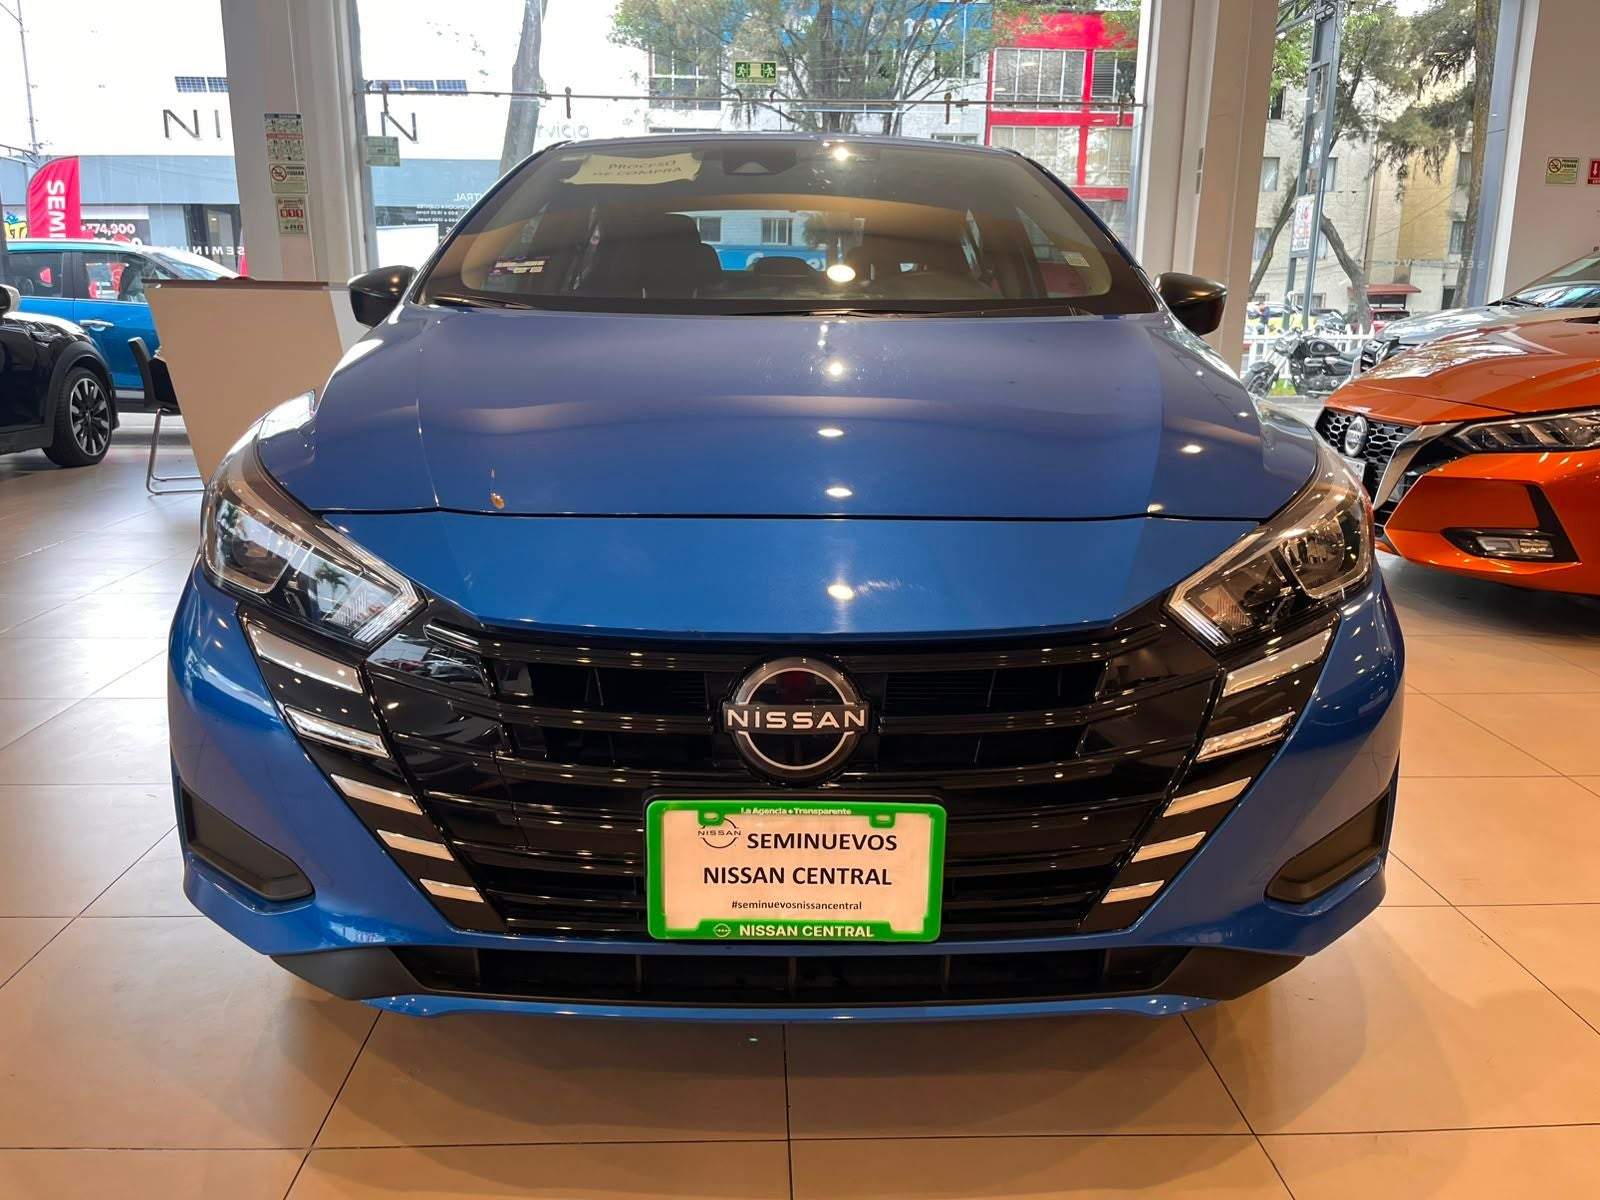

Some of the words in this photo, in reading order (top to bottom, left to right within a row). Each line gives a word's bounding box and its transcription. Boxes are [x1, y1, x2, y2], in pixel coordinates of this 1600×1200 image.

[537, 122, 590, 139] rvicio
[608, 160, 677, 170] PROCESO
[616, 167, 682, 176] COMPRA
[727, 707, 865, 729] NISSAN
[740, 807, 751, 815] La
[752, 807, 787, 816] Agencia
[697, 829, 742, 837] NISSAN
[747, 832, 898, 851] SEMINUEVOS
[703, 866, 785, 884] NISSAN
[792, 866, 893, 886] CENTRAL
[731, 899, 862, 911] #seminuevosnissancentral
[739, 924, 798, 937] NISSAN
[802, 924, 874, 938] CENTRAL
